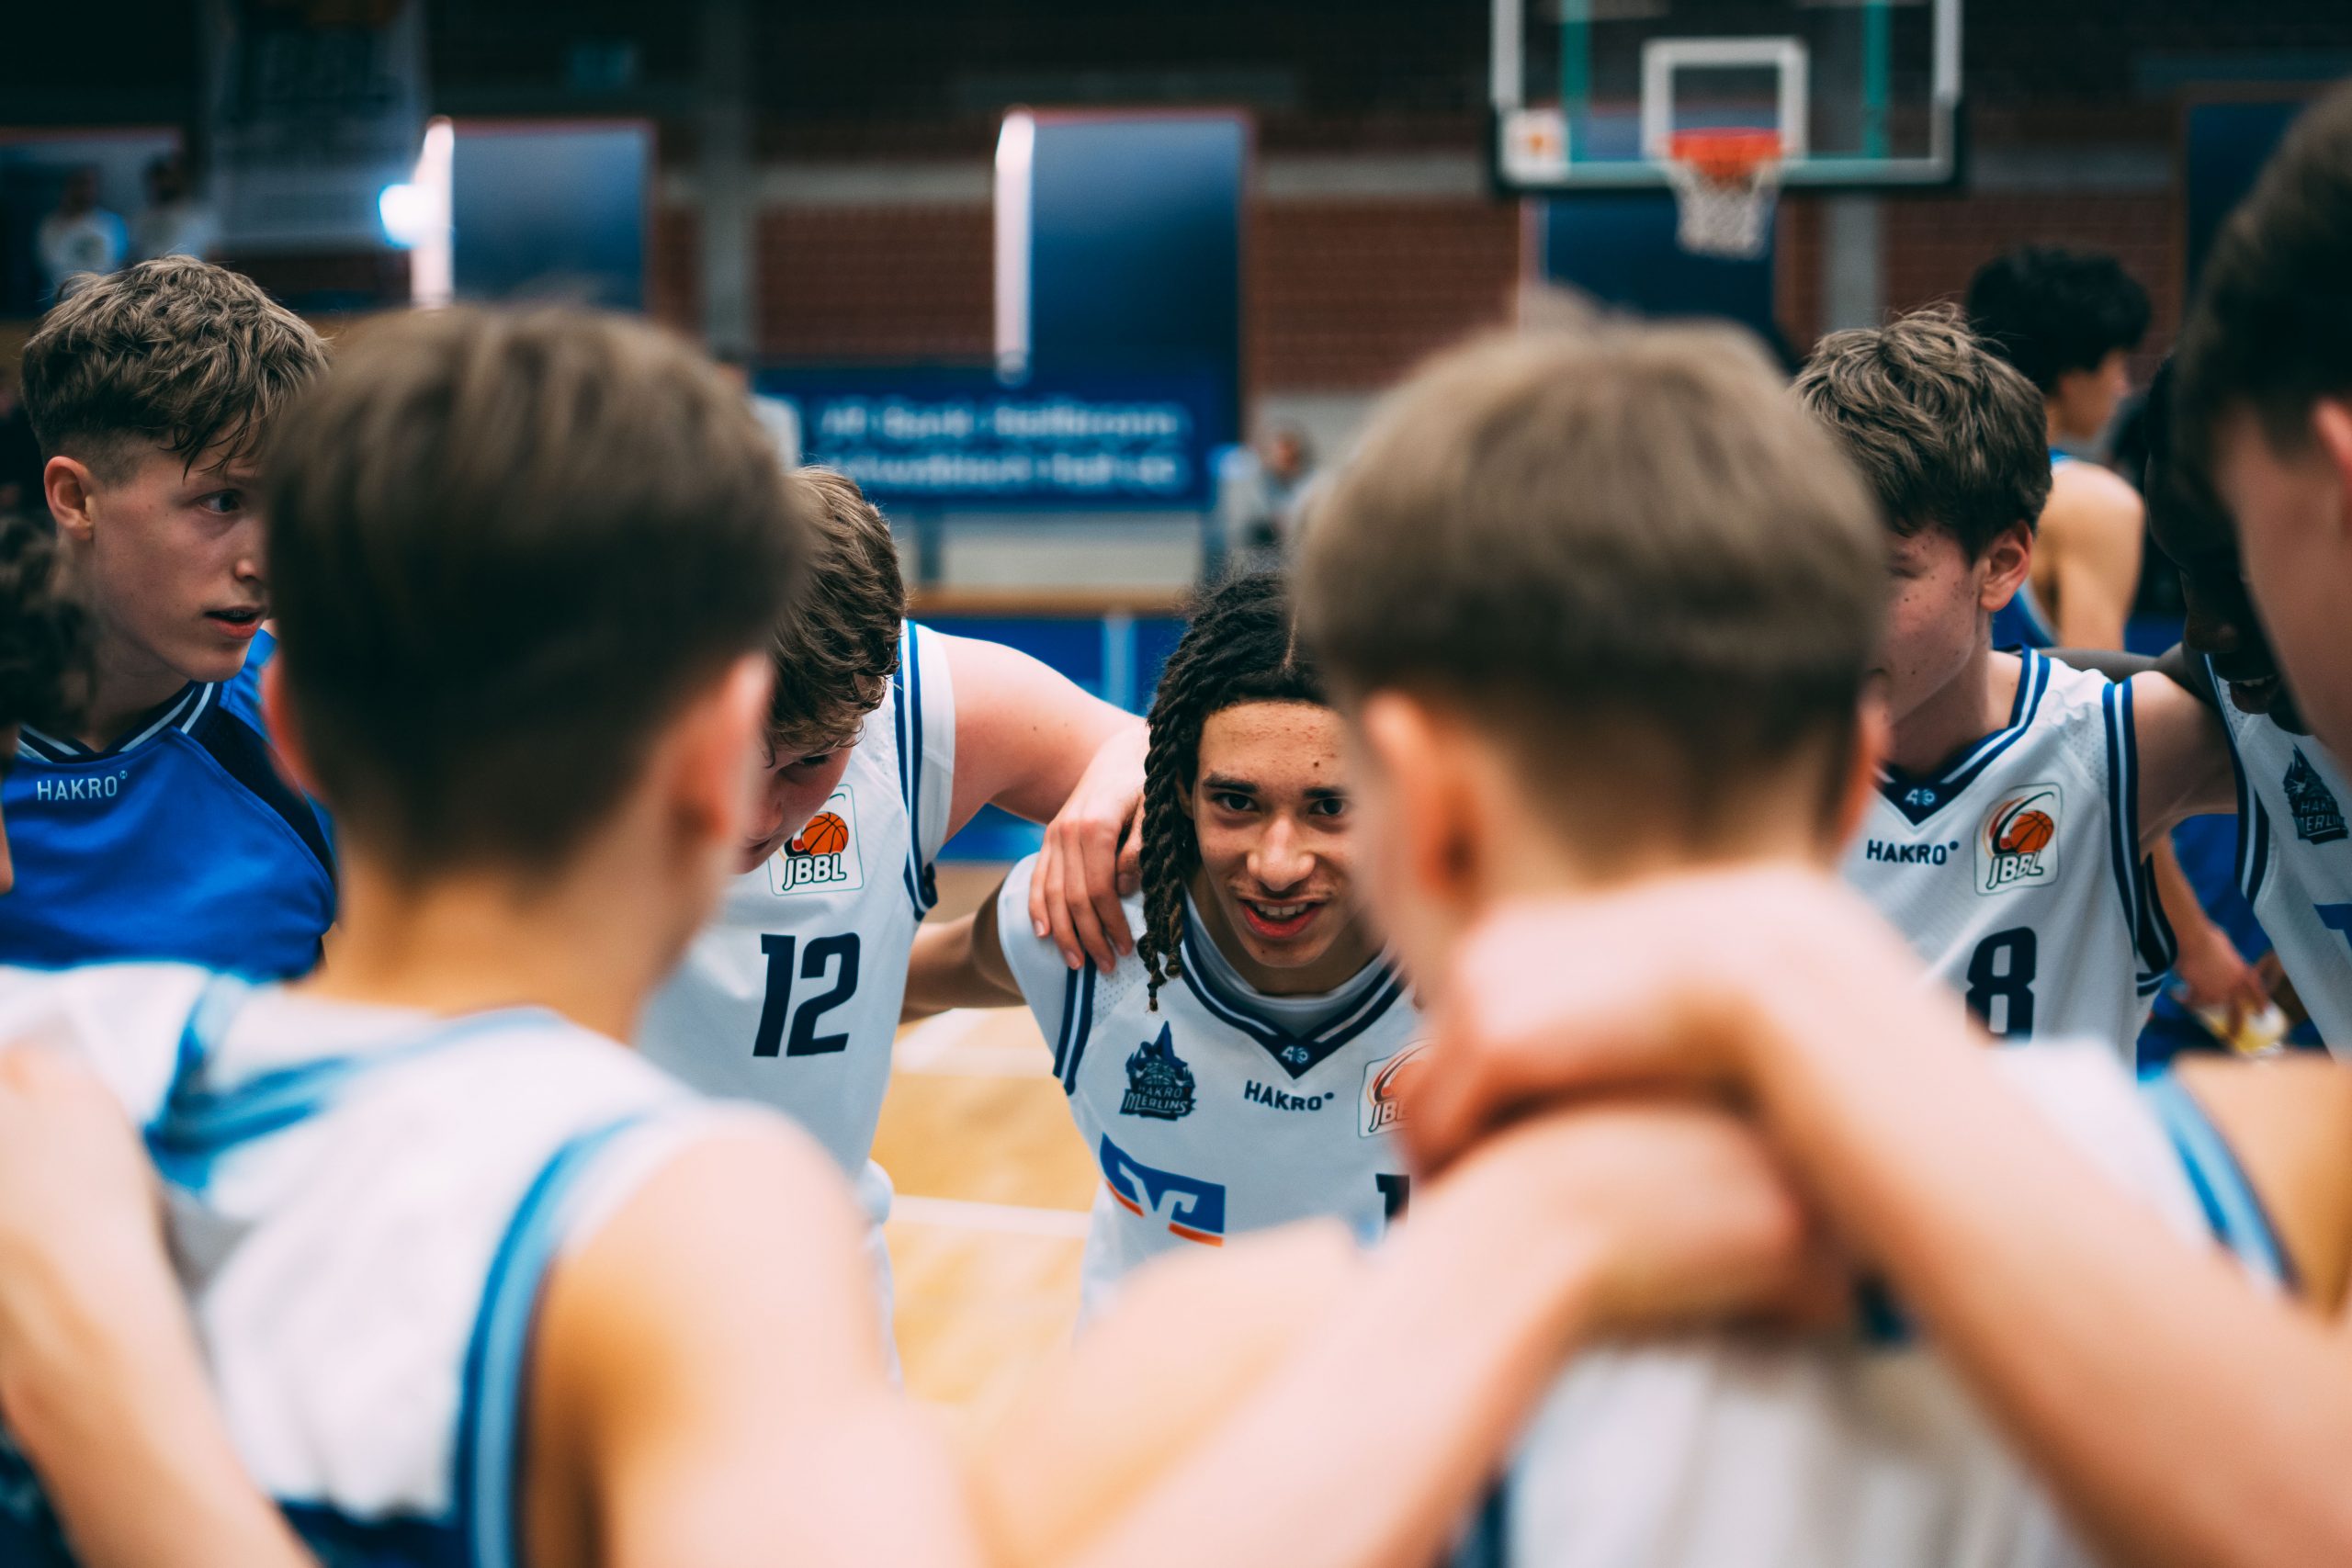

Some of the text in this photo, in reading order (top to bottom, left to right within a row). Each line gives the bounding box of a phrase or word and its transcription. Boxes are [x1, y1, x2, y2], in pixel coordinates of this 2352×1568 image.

[37, 776, 118, 801] HAKRO
[1866, 839, 1947, 865] HAKRO
[782, 853, 847, 890] JBBL
[1985, 851, 2044, 890] JBBL
[752, 931, 861, 1057] 12
[1965, 926, 2037, 1048] 8
[1124, 1091, 1189, 1114] MERLINS
[1244, 1079, 1322, 1111] HAKRO
